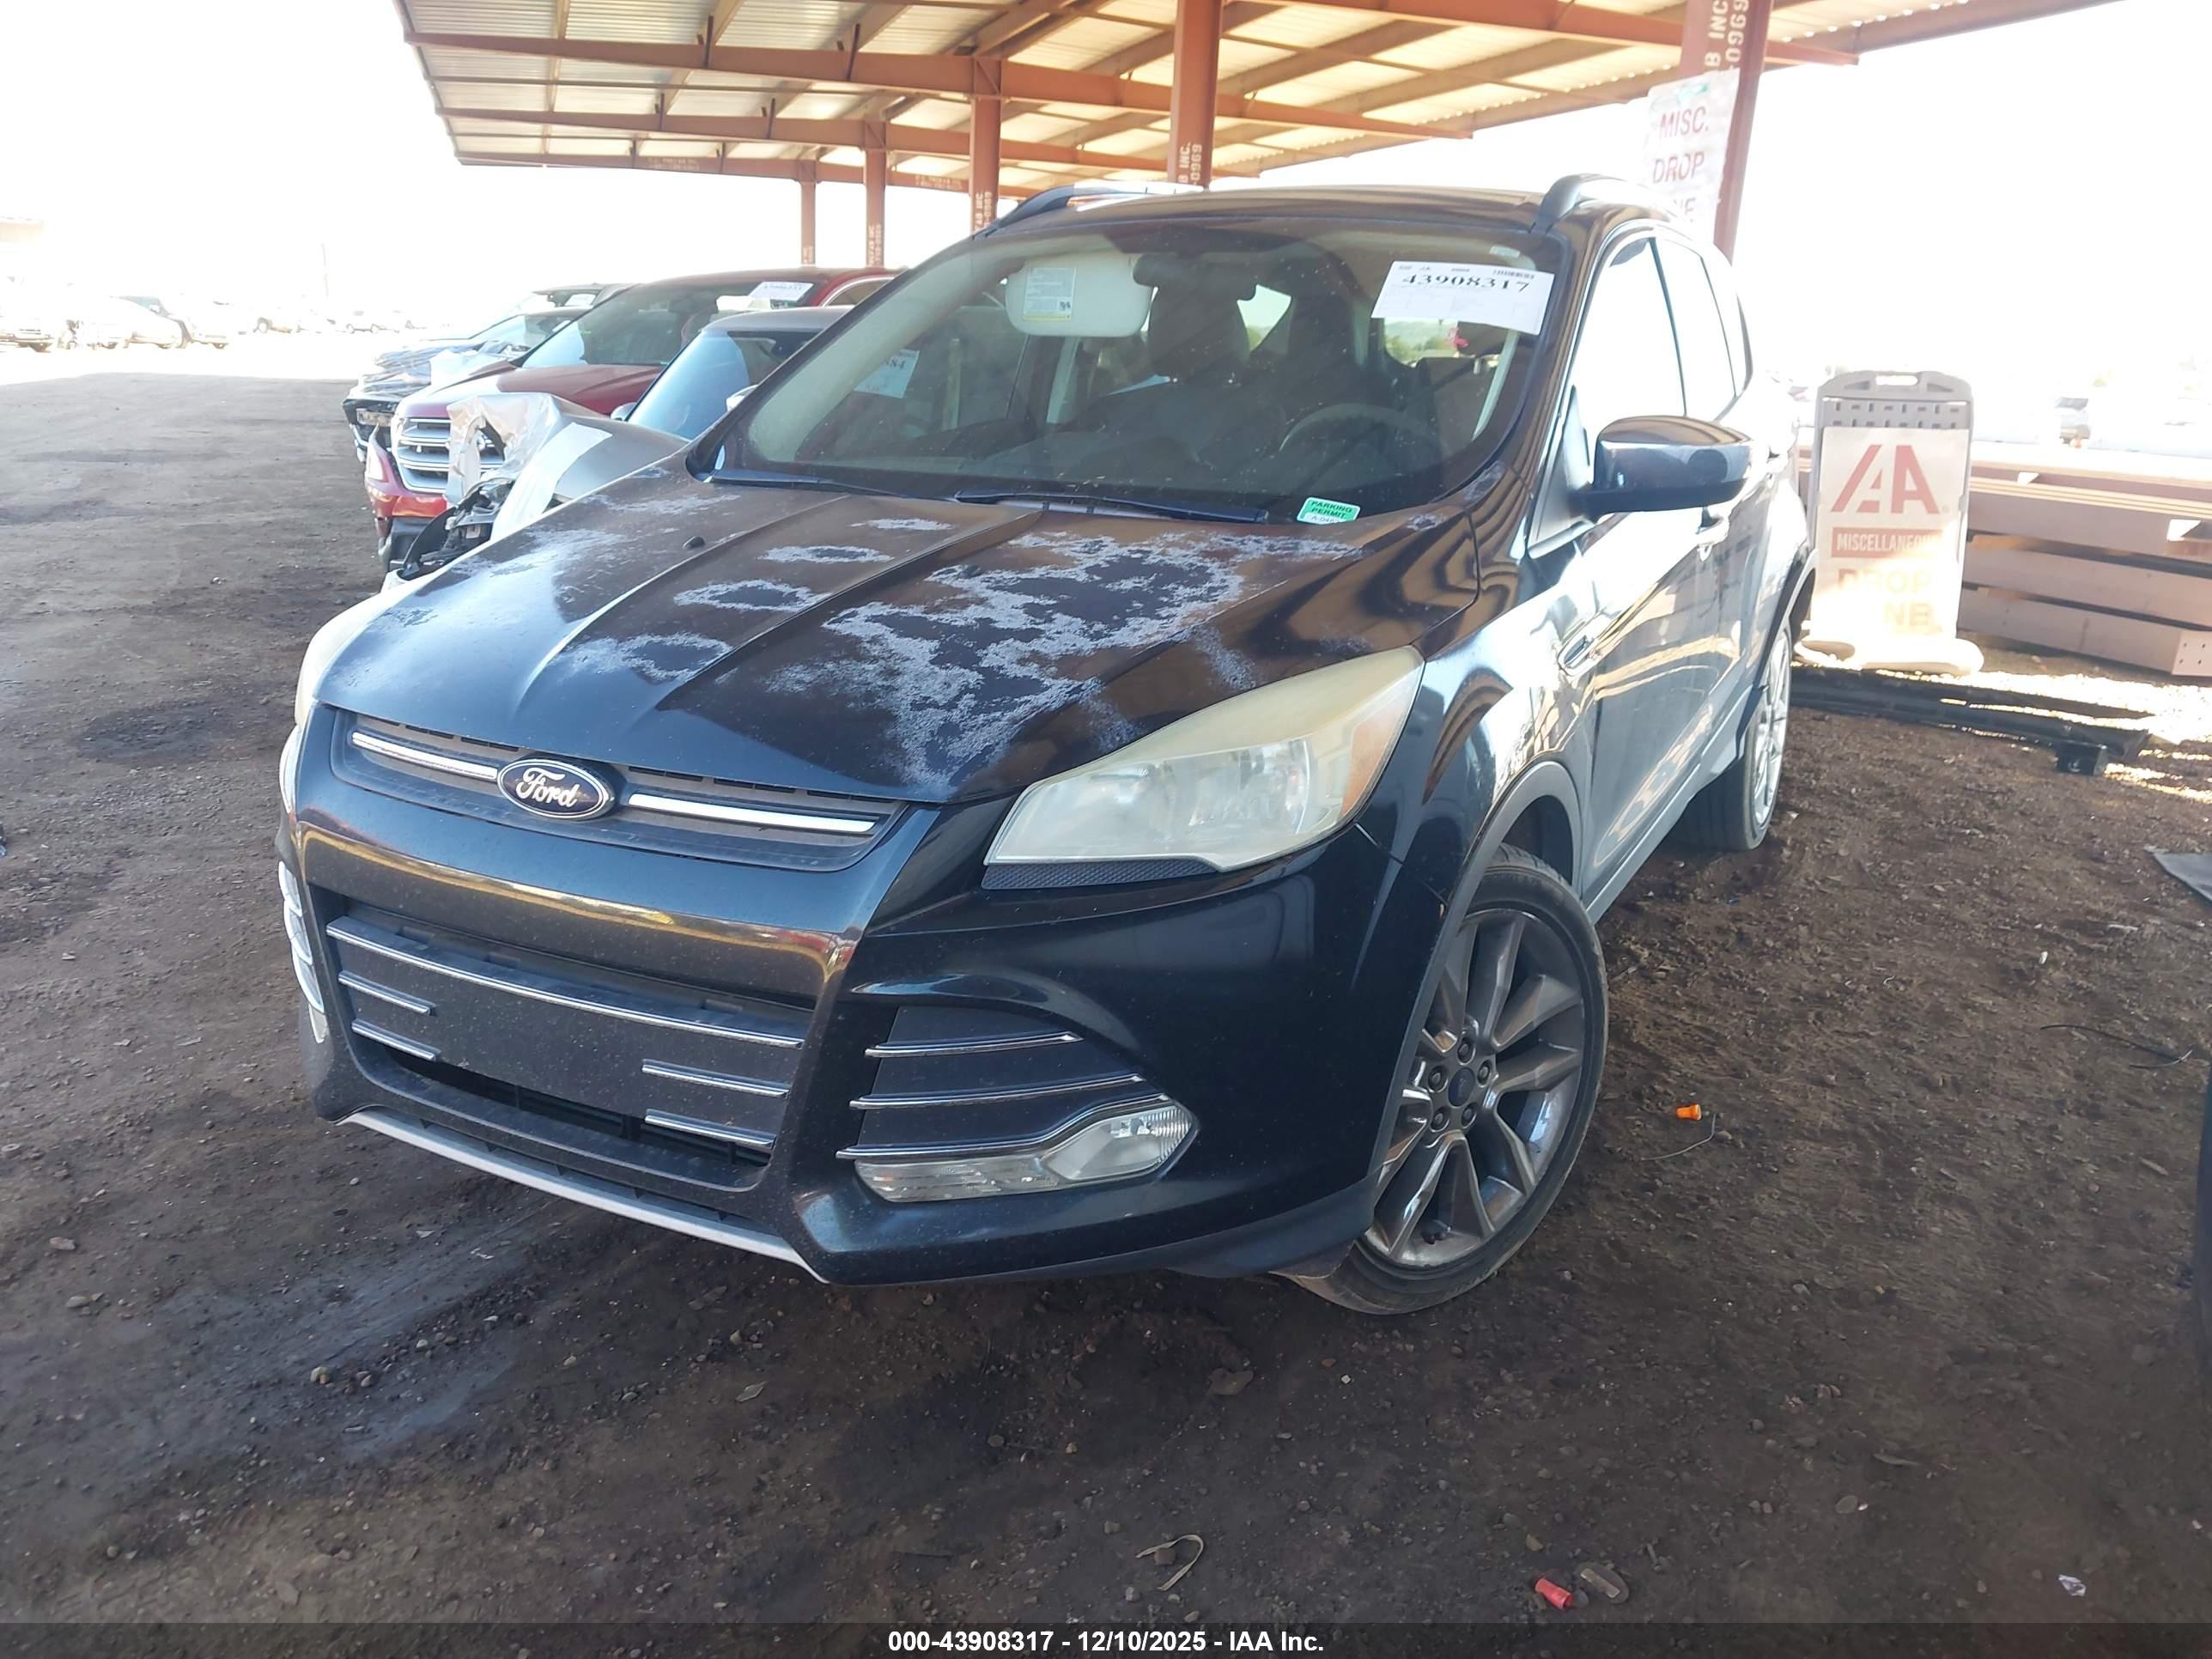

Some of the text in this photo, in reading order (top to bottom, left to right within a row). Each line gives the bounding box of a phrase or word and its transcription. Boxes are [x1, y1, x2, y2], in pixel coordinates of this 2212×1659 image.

[1659, 106, 1709, 137] MISC.
[1653, 151, 1705, 184] DROP
[1402, 274, 1530, 292] 43908317
[1311, 501, 1353, 514] PARKING
[1311, 507, 1346, 519] PERMIT
[1836, 533, 1942, 550] MISCELLANEOU
[516, 768, 581, 807] Ford
